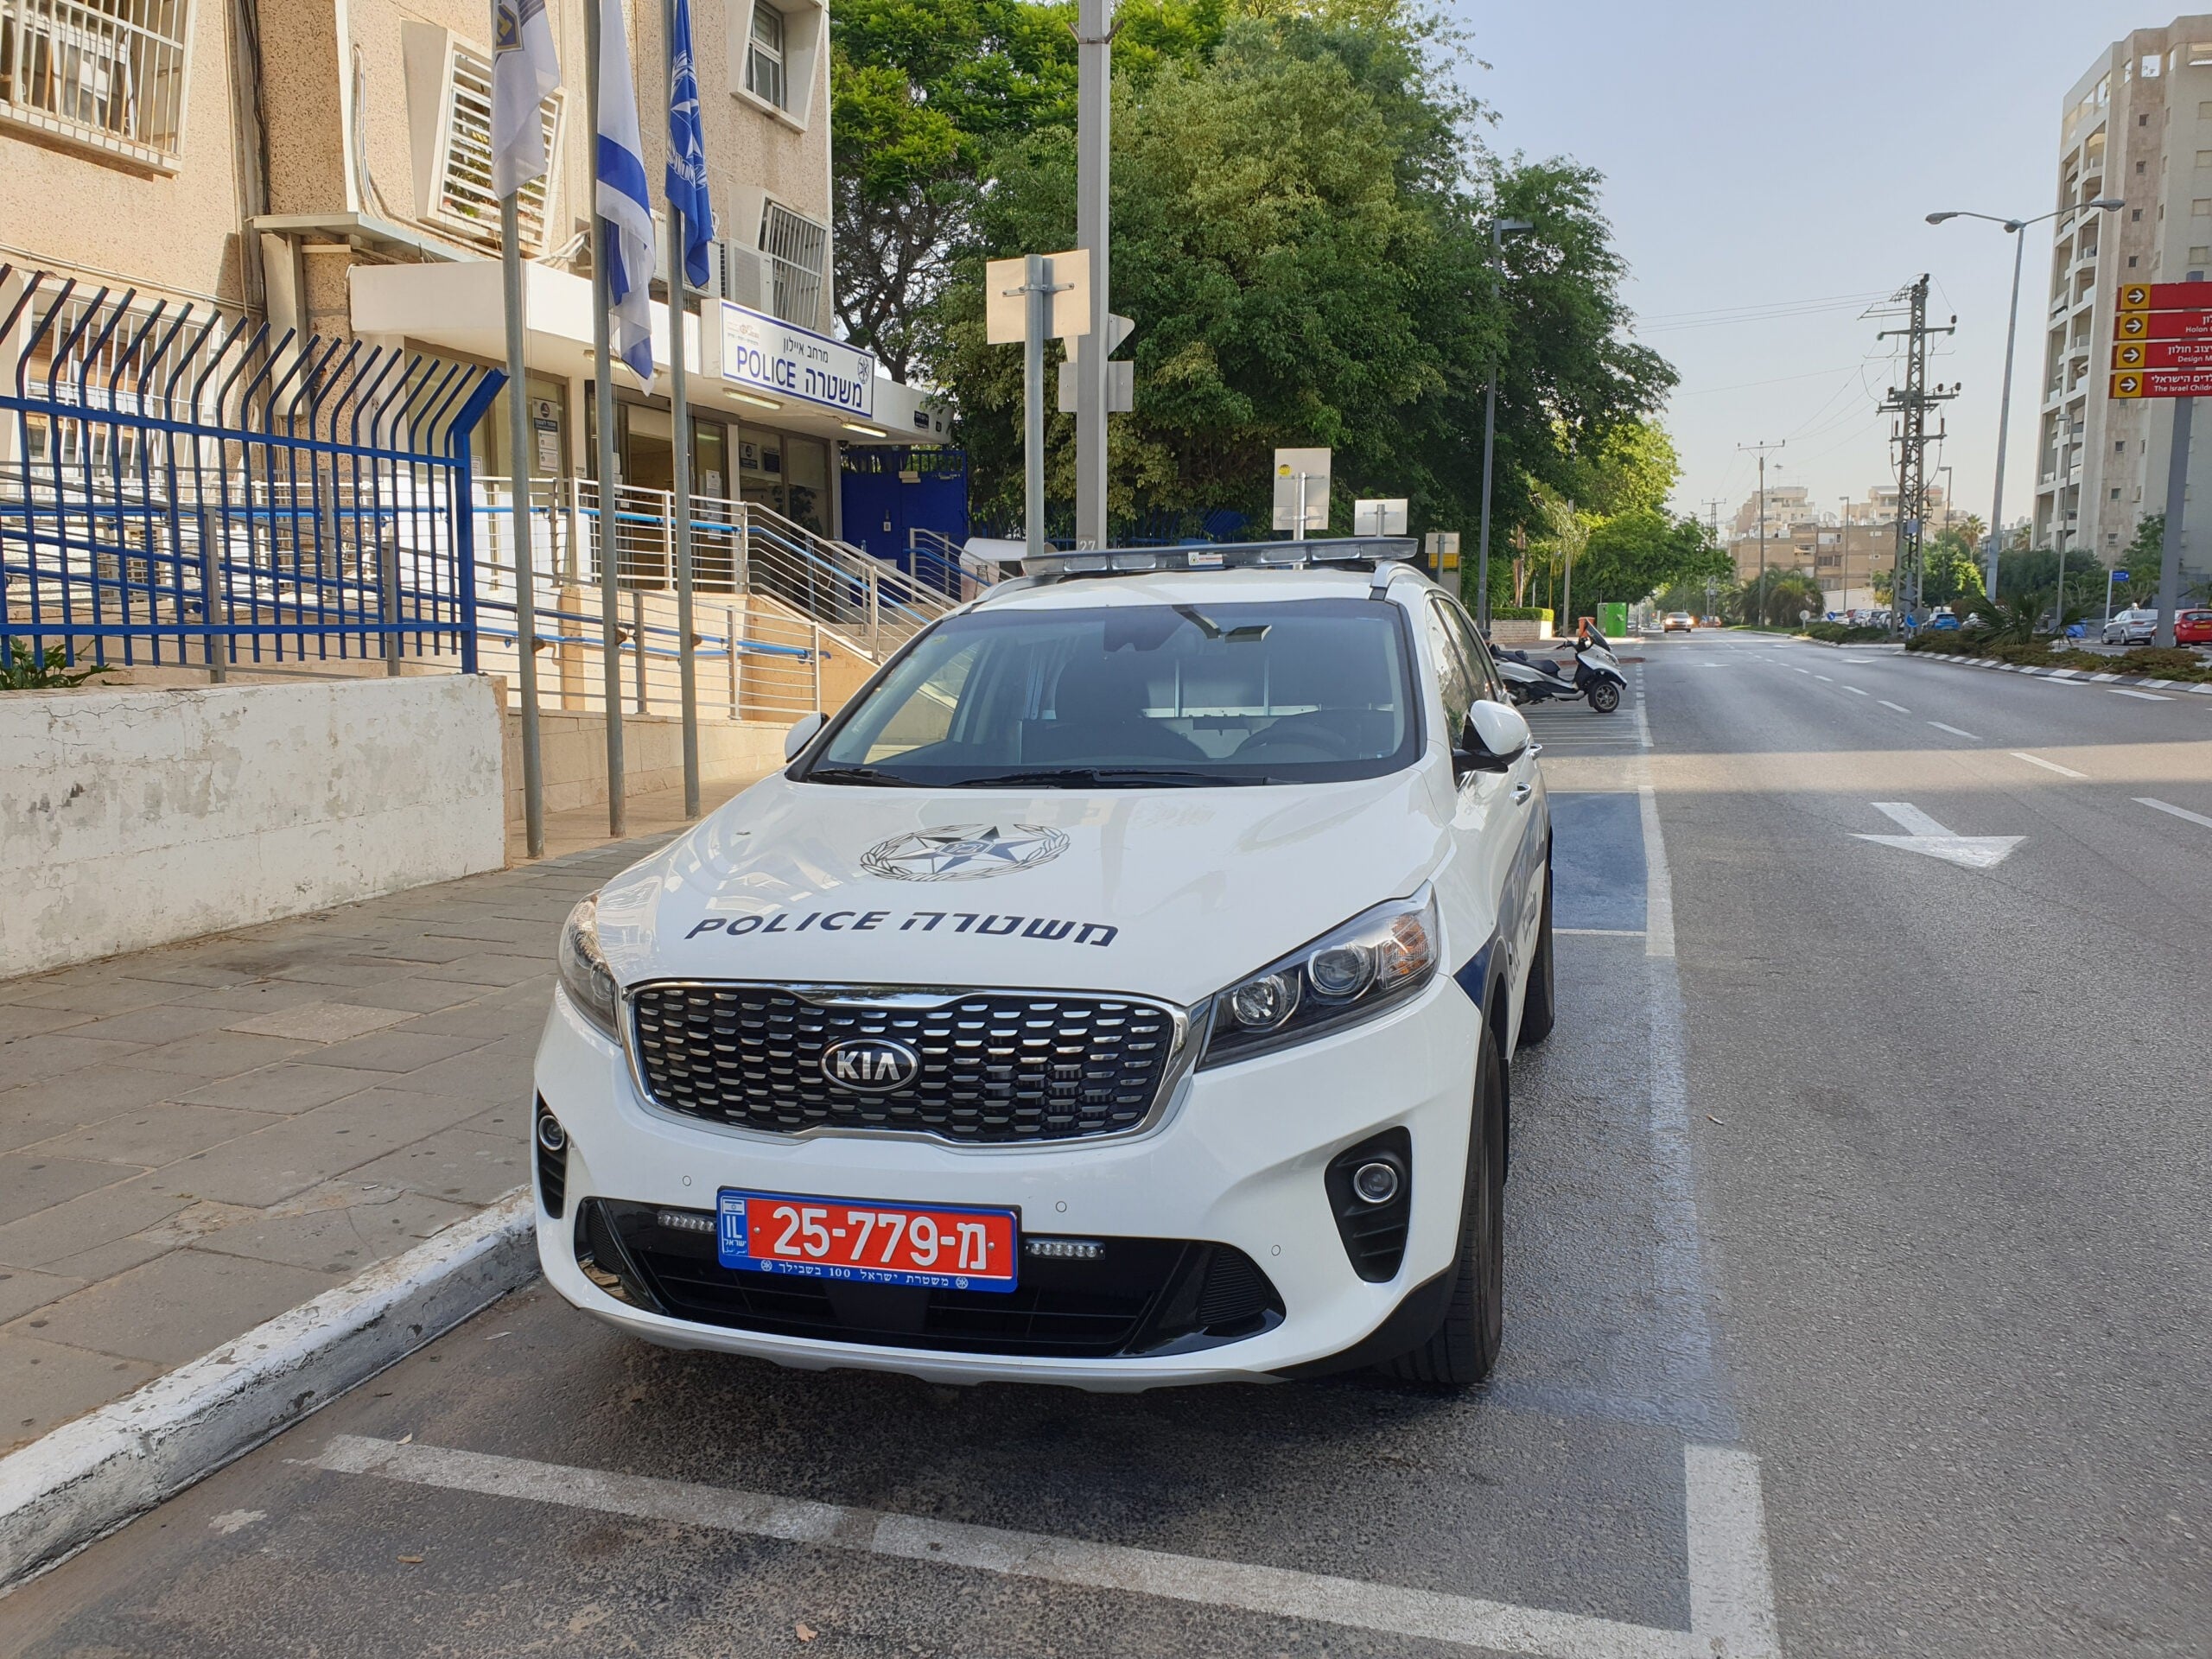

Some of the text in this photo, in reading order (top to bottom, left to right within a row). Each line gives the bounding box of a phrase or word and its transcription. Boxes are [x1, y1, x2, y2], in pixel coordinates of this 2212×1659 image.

[783, 336, 829, 363] מרחב איילון
[2168, 345, 2191, 355] חולון
[737, 346, 862, 408] POLICE משטרה
[684, 911, 1119, 947] POLICE משטרה
[836, 1050, 900, 1080] KIA
[727, 1215, 742, 1239] IL
[723, 1238, 747, 1247] ישראל
[779, 1262, 949, 1287] משטרת ישראל 100 בשבילך
